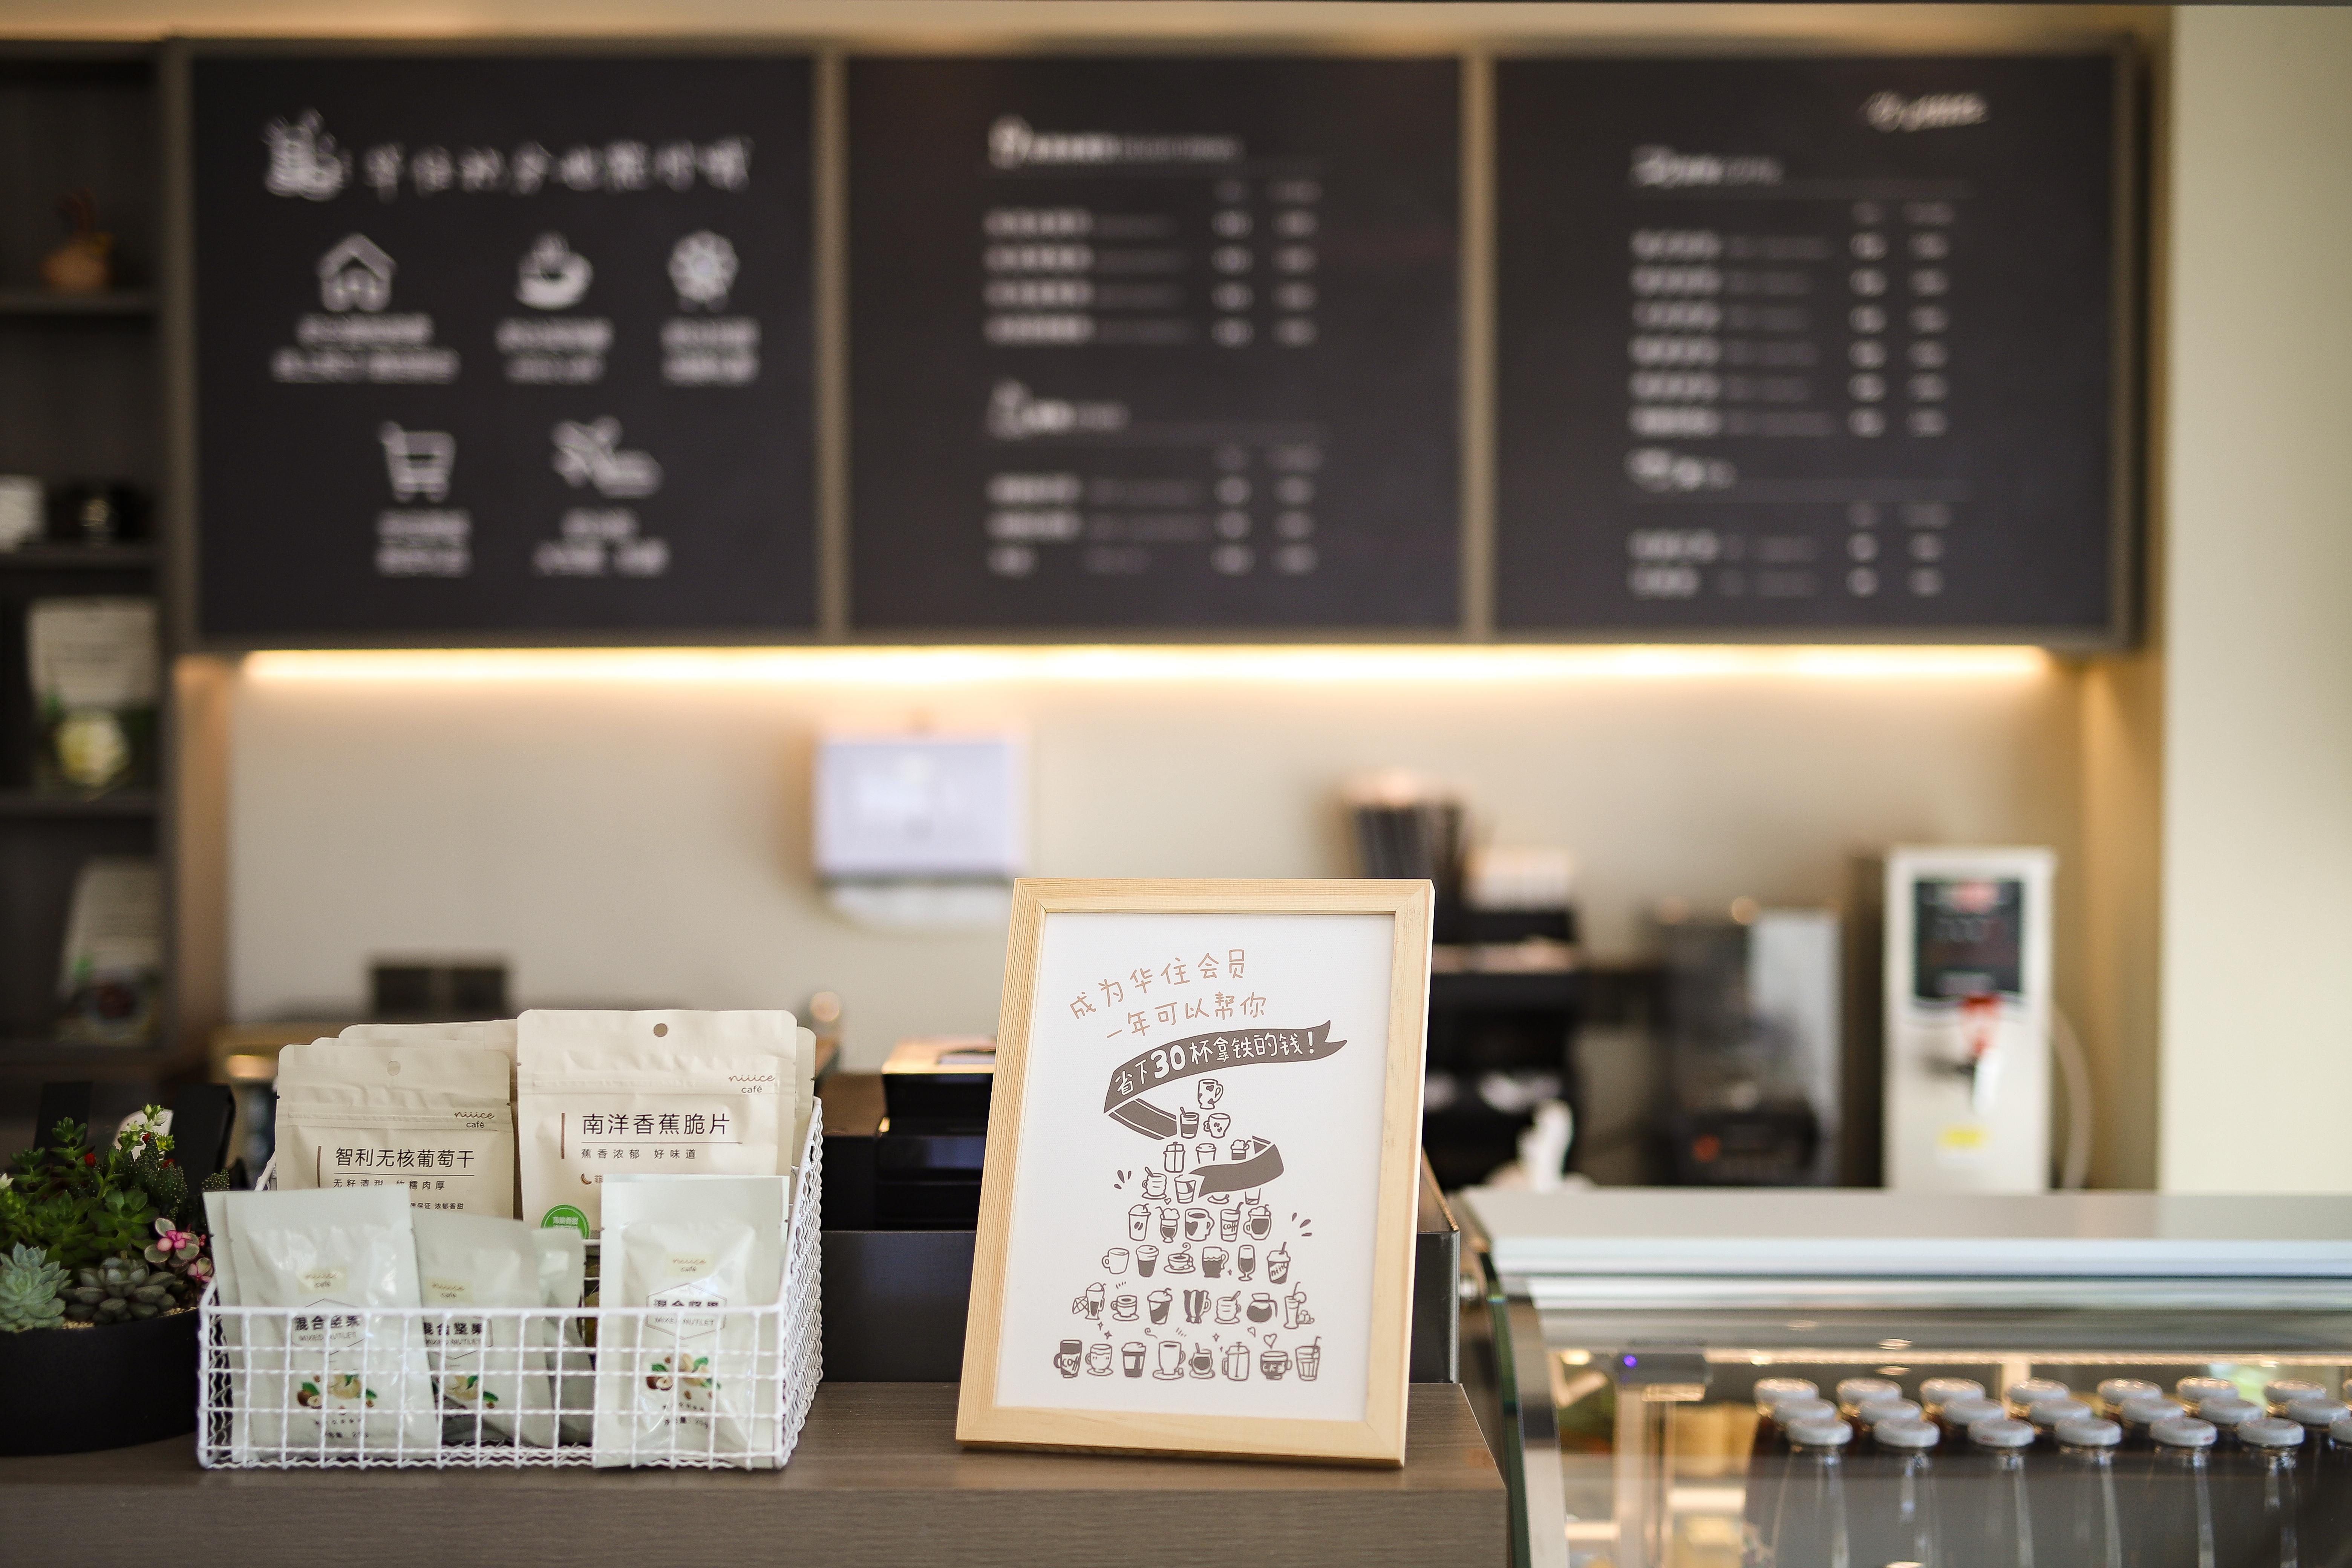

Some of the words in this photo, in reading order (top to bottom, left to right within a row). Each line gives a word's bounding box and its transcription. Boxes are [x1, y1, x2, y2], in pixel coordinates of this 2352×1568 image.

[1070, 949, 1245, 1019] 成为华住会员
[1107, 991, 1267, 1039] 一年可以帮你
[728, 1075, 776, 1083] niiice
[741, 1085, 763, 1094] café
[582, 1113, 730, 1135] 南洋香蕉脆片
[335, 1147, 475, 1169] 智利无核葡萄干
[581, 1148, 640, 1160] 蕉香浓郁
[654, 1149, 697, 1160] 好味道
